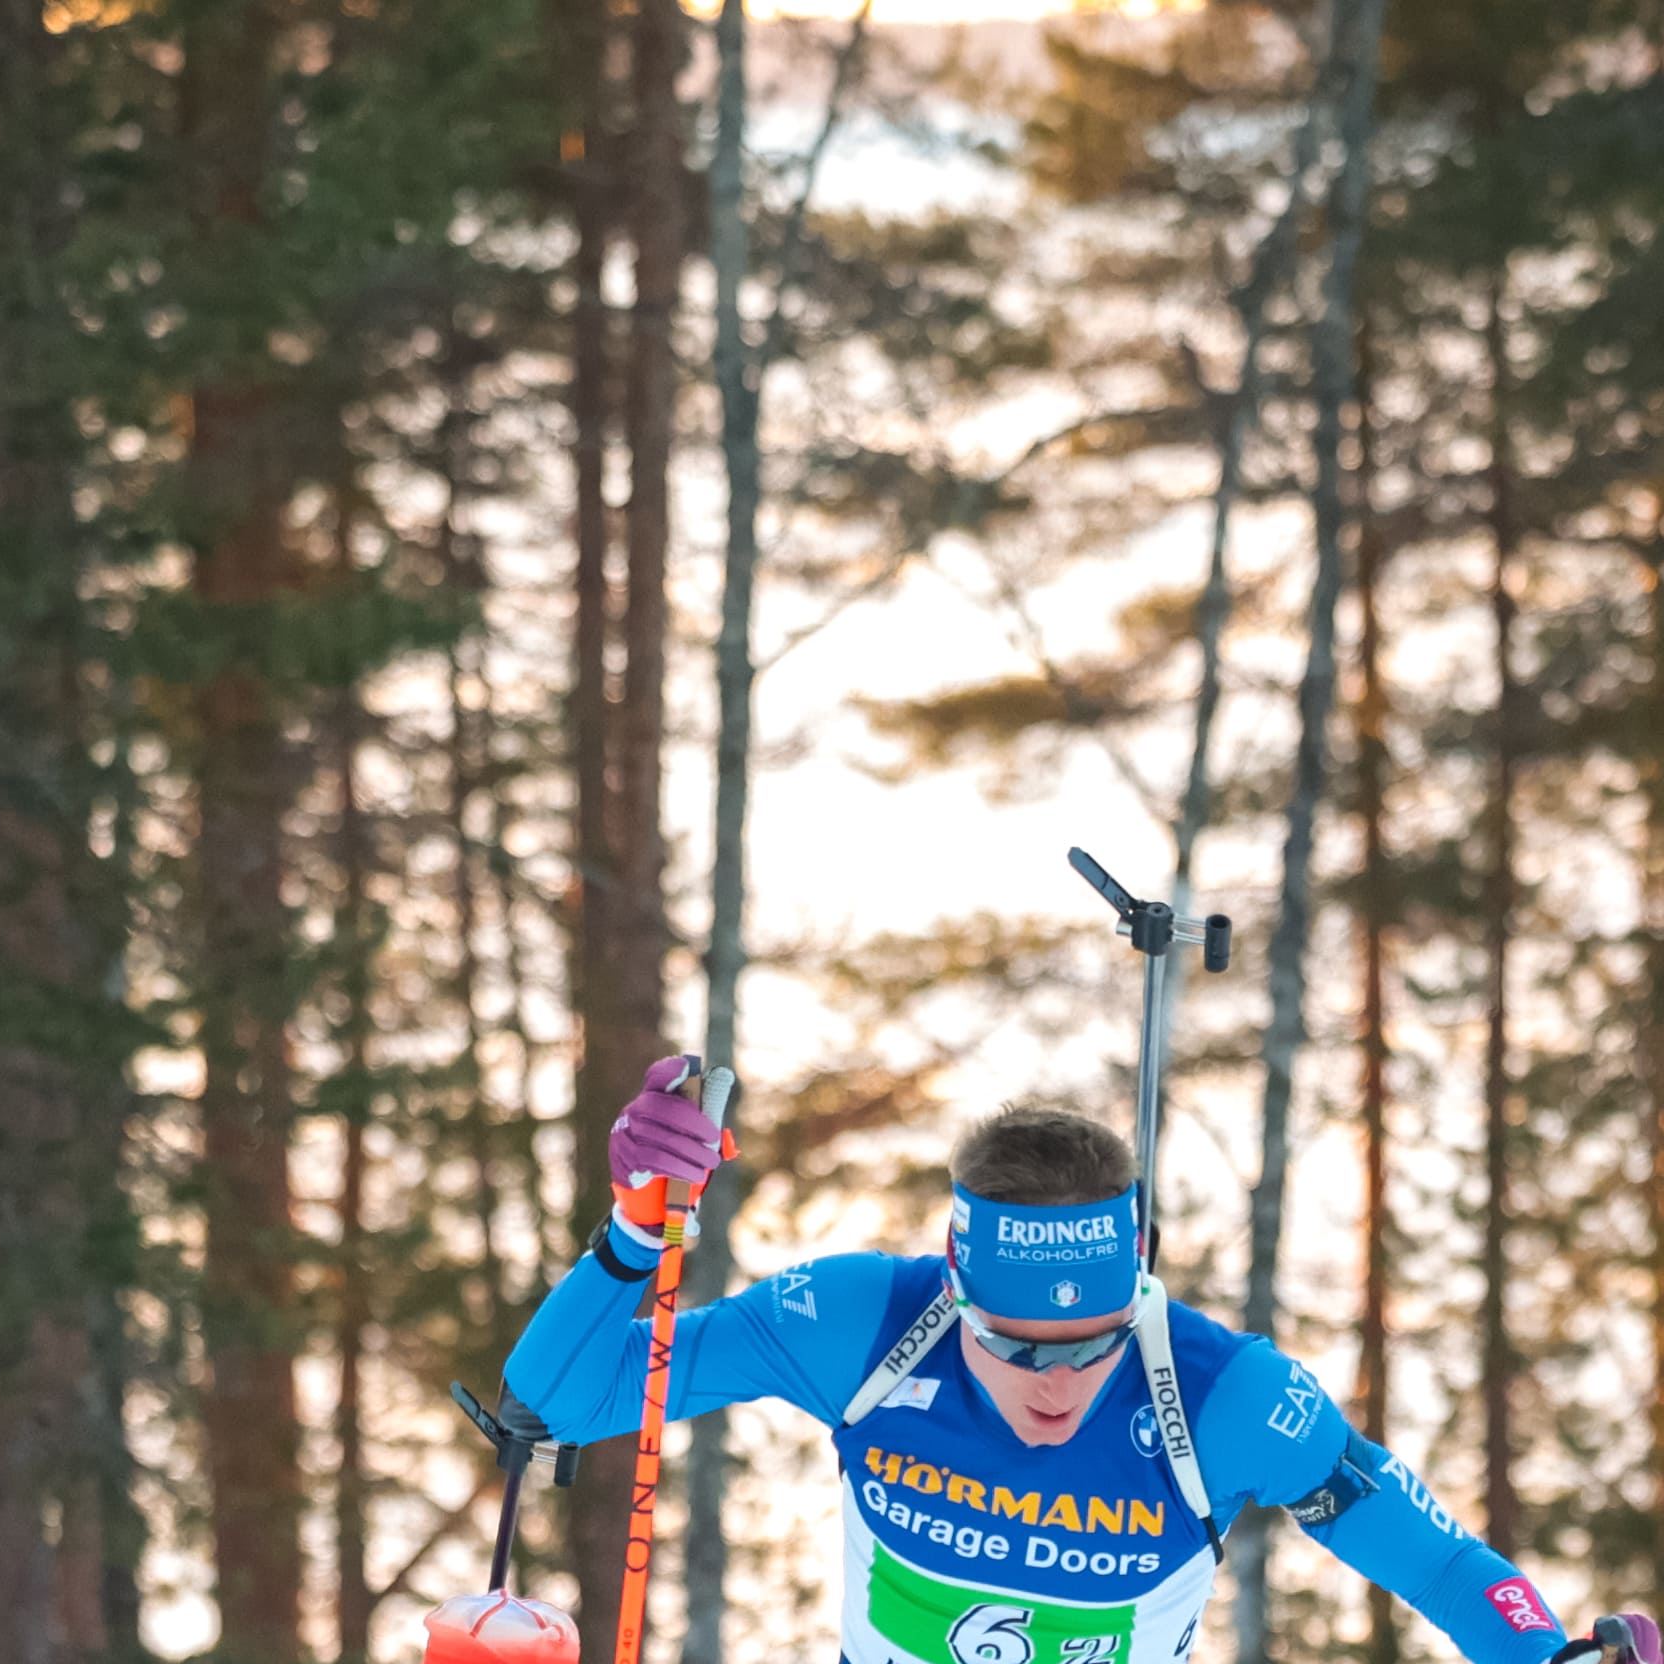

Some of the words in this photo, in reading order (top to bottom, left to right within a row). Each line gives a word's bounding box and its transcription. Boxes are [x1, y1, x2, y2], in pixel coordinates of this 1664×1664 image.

[996, 1214, 1118, 1247] ERDINGER
[996, 1241, 1118, 1262] ALKOHOLFREI
[884, 1294, 954, 1376] FIOCCHI
[1153, 1366, 1191, 1459] FIOCCHI
[864, 1446, 1165, 1537] HÖRMANN
[861, 1480, 1010, 1559] Garage
[1025, 1536, 1161, 1576] Doors
[1493, 1585, 1549, 1630] enel
[623, 1628, 634, 1651] 40
